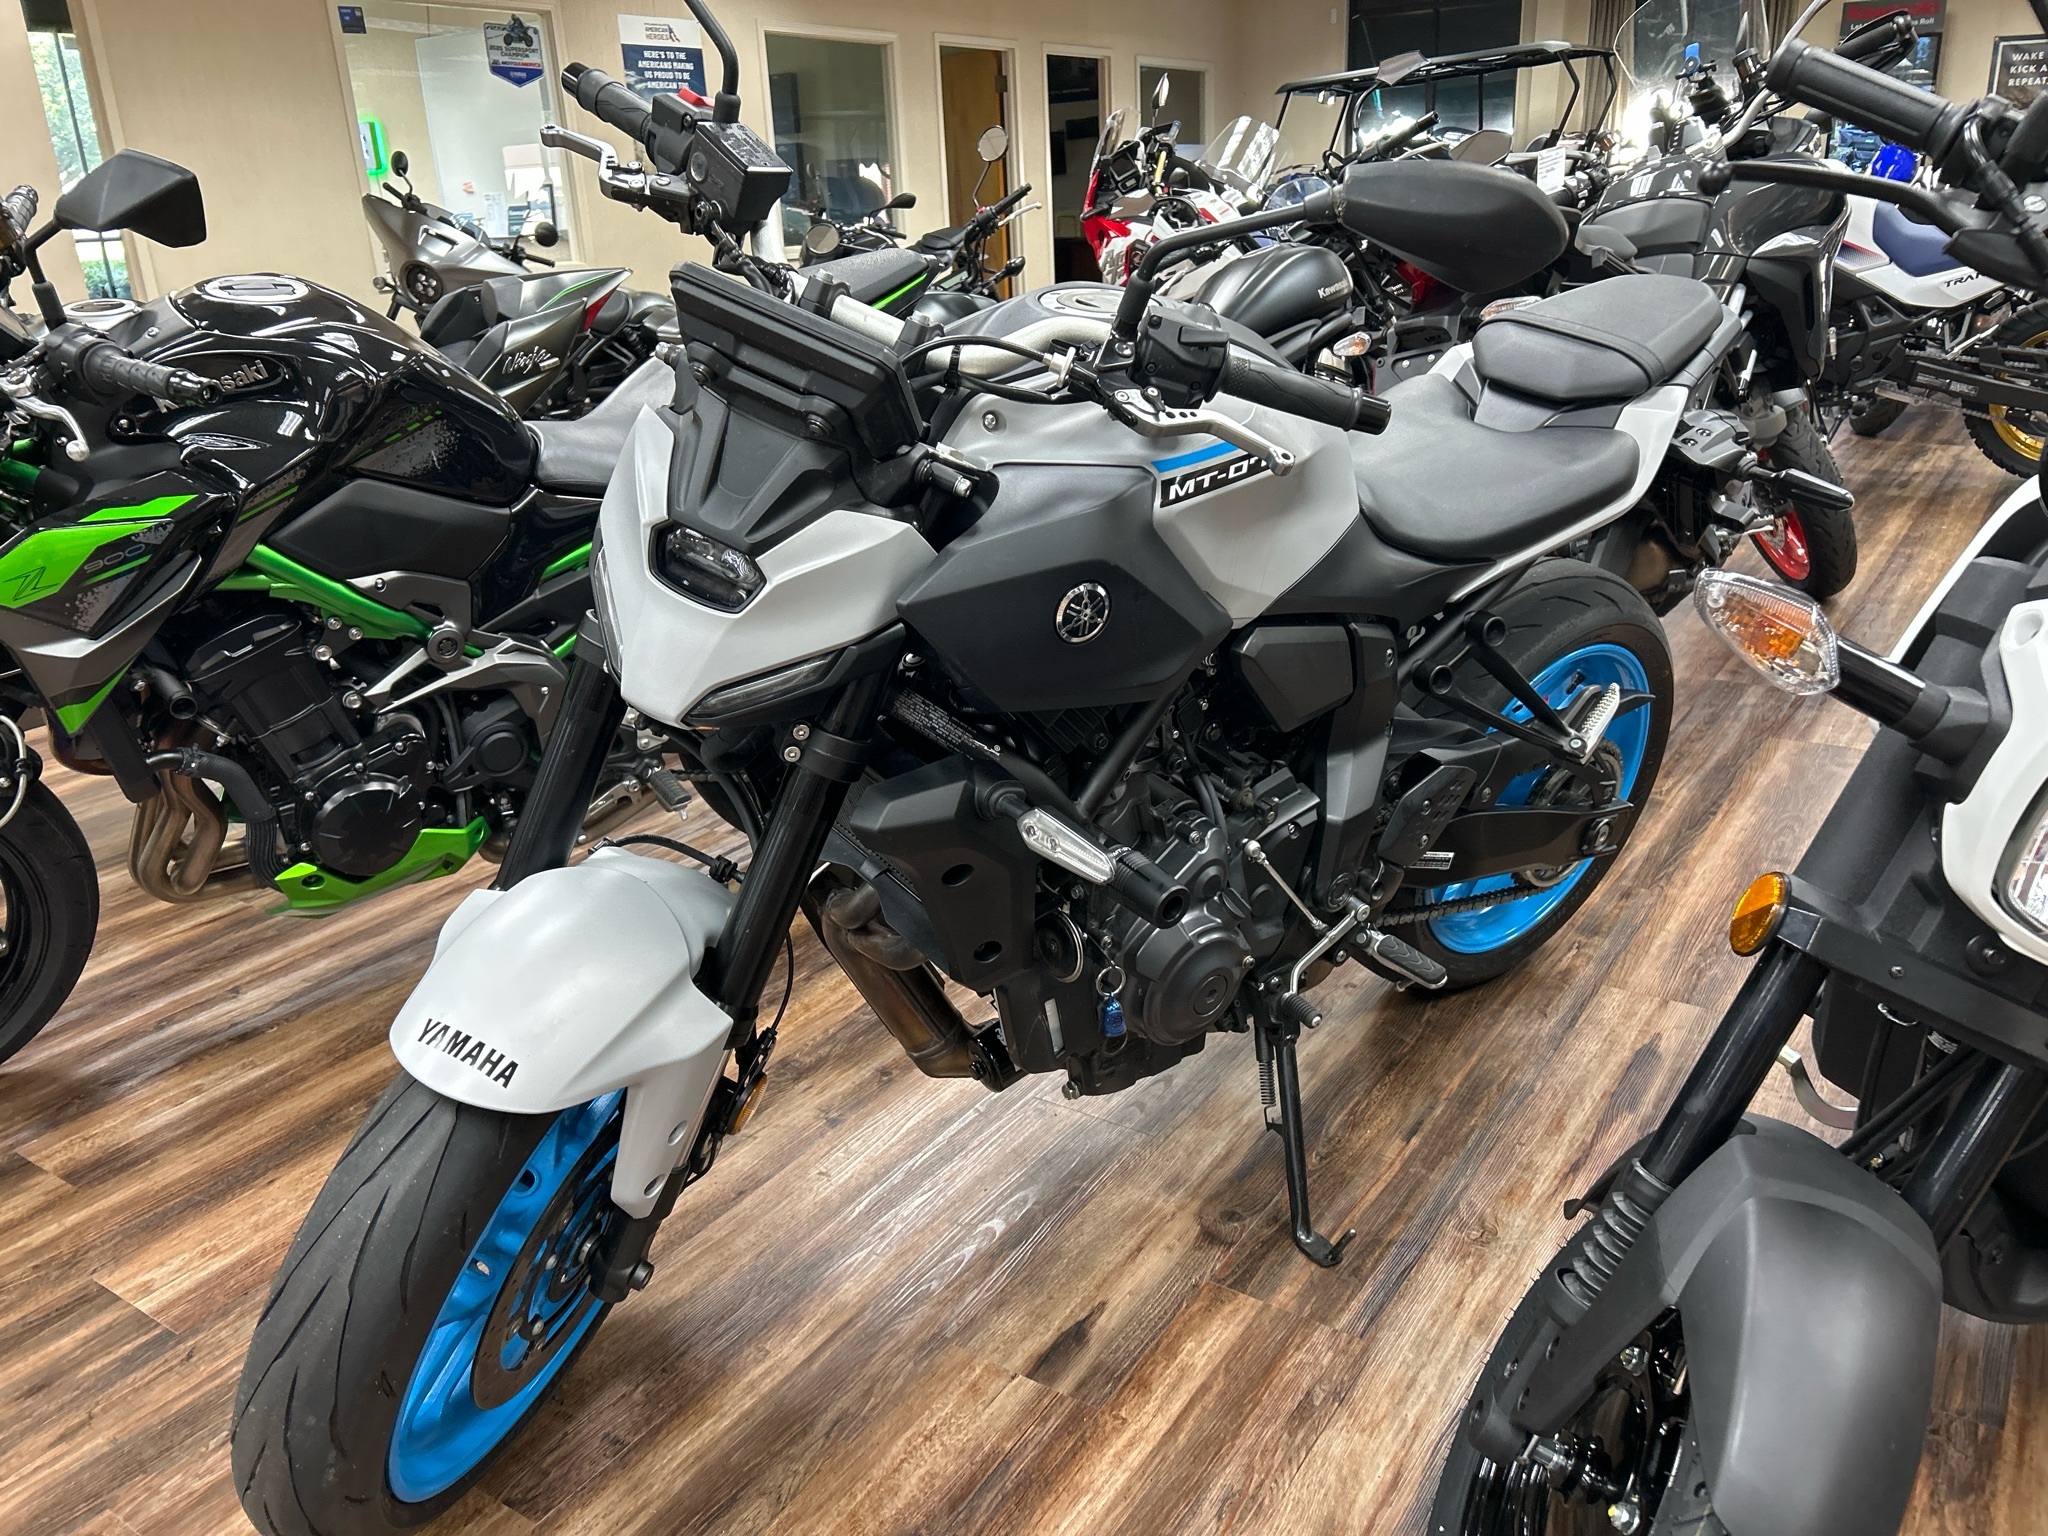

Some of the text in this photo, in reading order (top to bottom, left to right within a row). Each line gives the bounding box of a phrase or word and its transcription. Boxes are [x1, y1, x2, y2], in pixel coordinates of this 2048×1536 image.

[504, 46, 539, 54] SUPERSPORT
[643, 50, 686, 60] HERE'S TO THE
[2012, 51, 2045, 61] WAKE
[638, 60, 694, 70] AMERICANS MAKING
[2009, 64, 2037, 74] KICK
[644, 71, 691, 80] US PROUD TO BE
[647, 81, 677, 89] AMERICAN
[501, 346, 551, 374] Ninja
[152, 359, 269, 414] Ksaki
[84, 543, 145, 574] 900
[417, 1018, 519, 1089] YAMAHA
